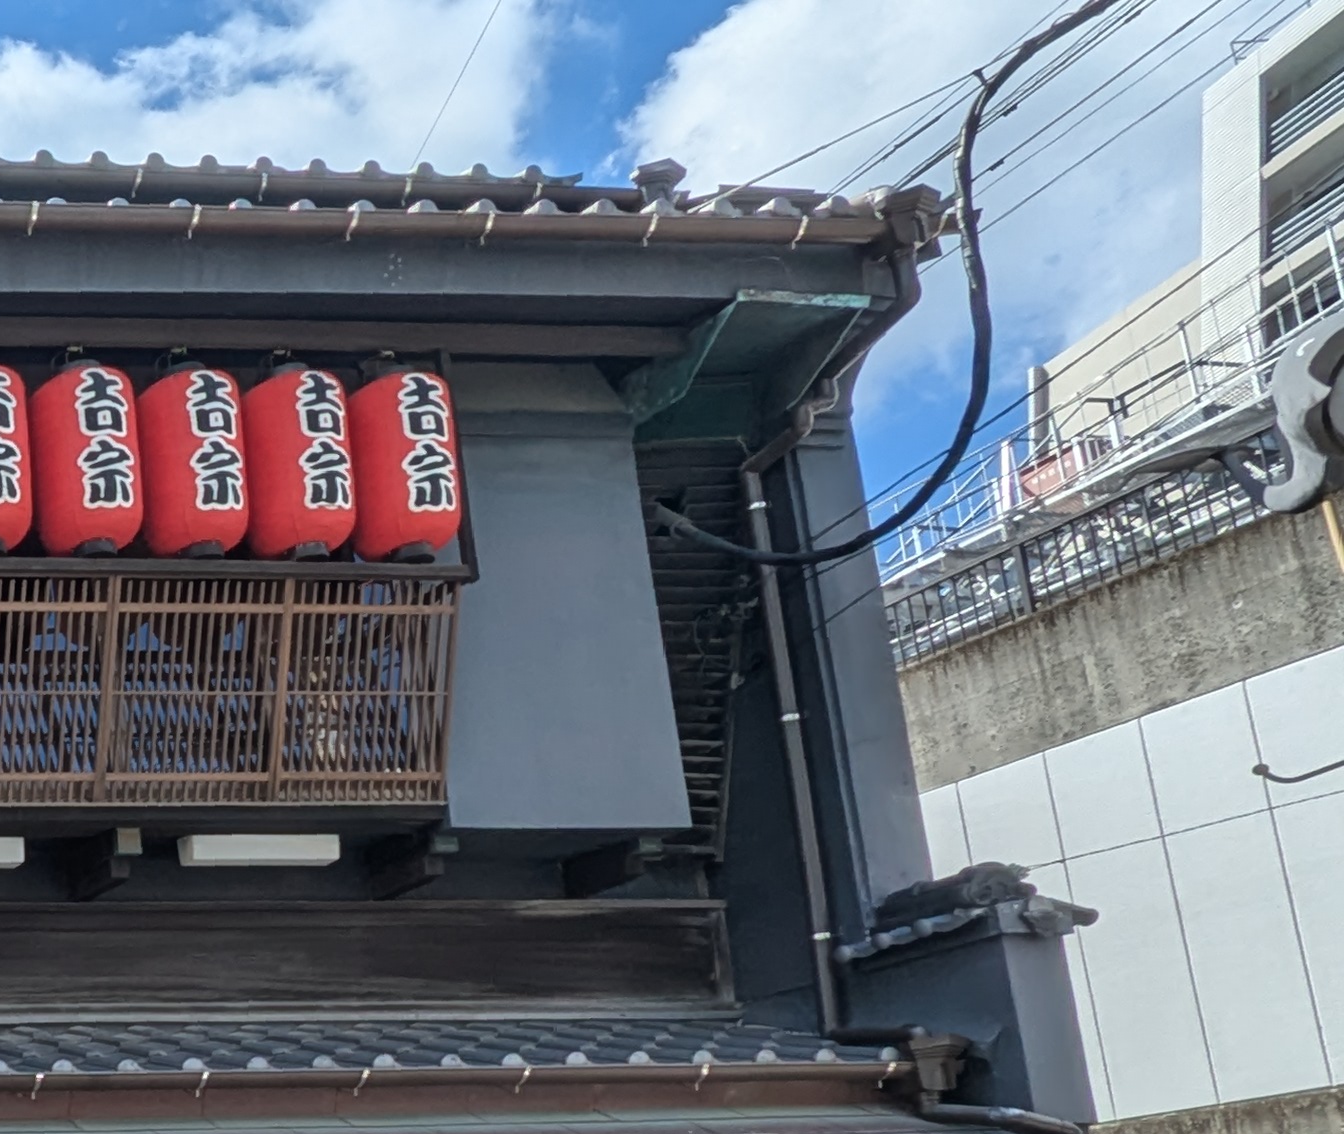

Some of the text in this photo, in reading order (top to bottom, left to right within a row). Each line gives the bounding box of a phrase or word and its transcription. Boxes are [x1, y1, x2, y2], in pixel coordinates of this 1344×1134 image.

[77, 367, 133, 509] 吉宗
[186, 370, 244, 511] 吉宗
[296, 370, 352, 509] 吉宗
[398, 373, 456, 512] 吉宗
